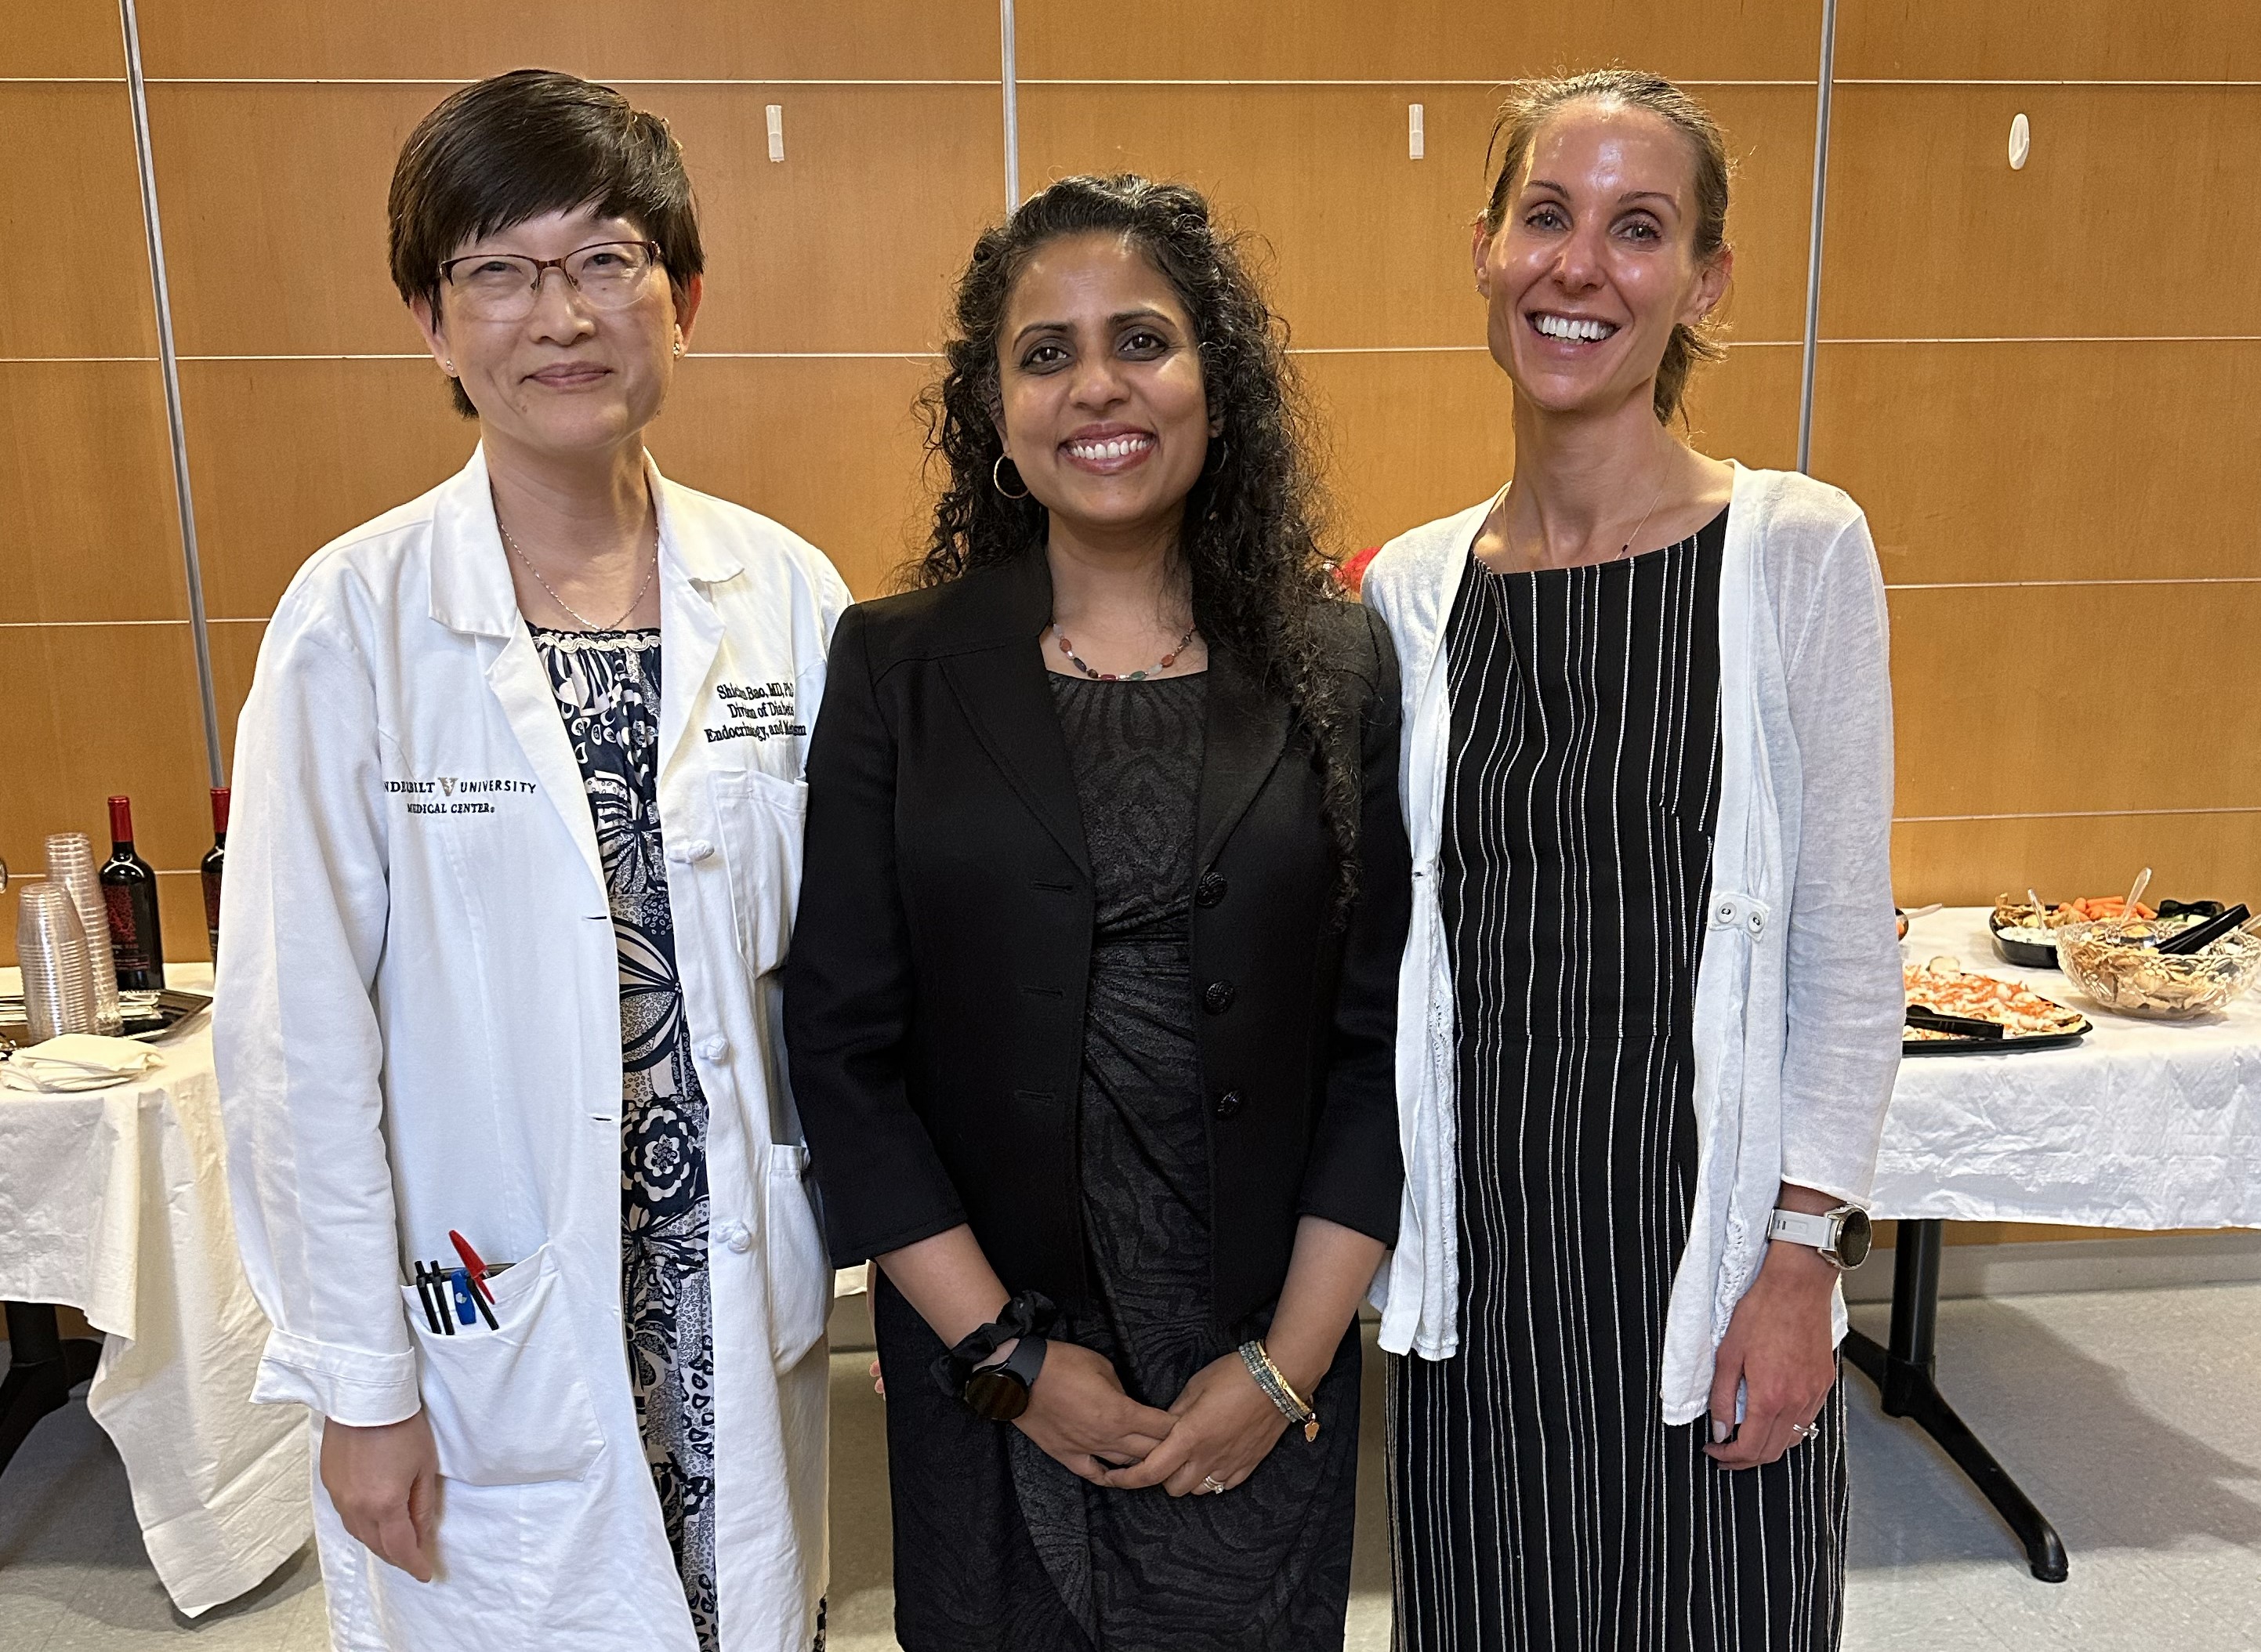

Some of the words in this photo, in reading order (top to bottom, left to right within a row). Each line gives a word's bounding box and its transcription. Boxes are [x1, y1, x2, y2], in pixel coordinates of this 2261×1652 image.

[745, 686, 769, 700] Bao,
[757, 701, 769, 717] of
[460, 780, 536, 794] UNIVERSITY
[407, 802, 447, 814] MEDICAL
